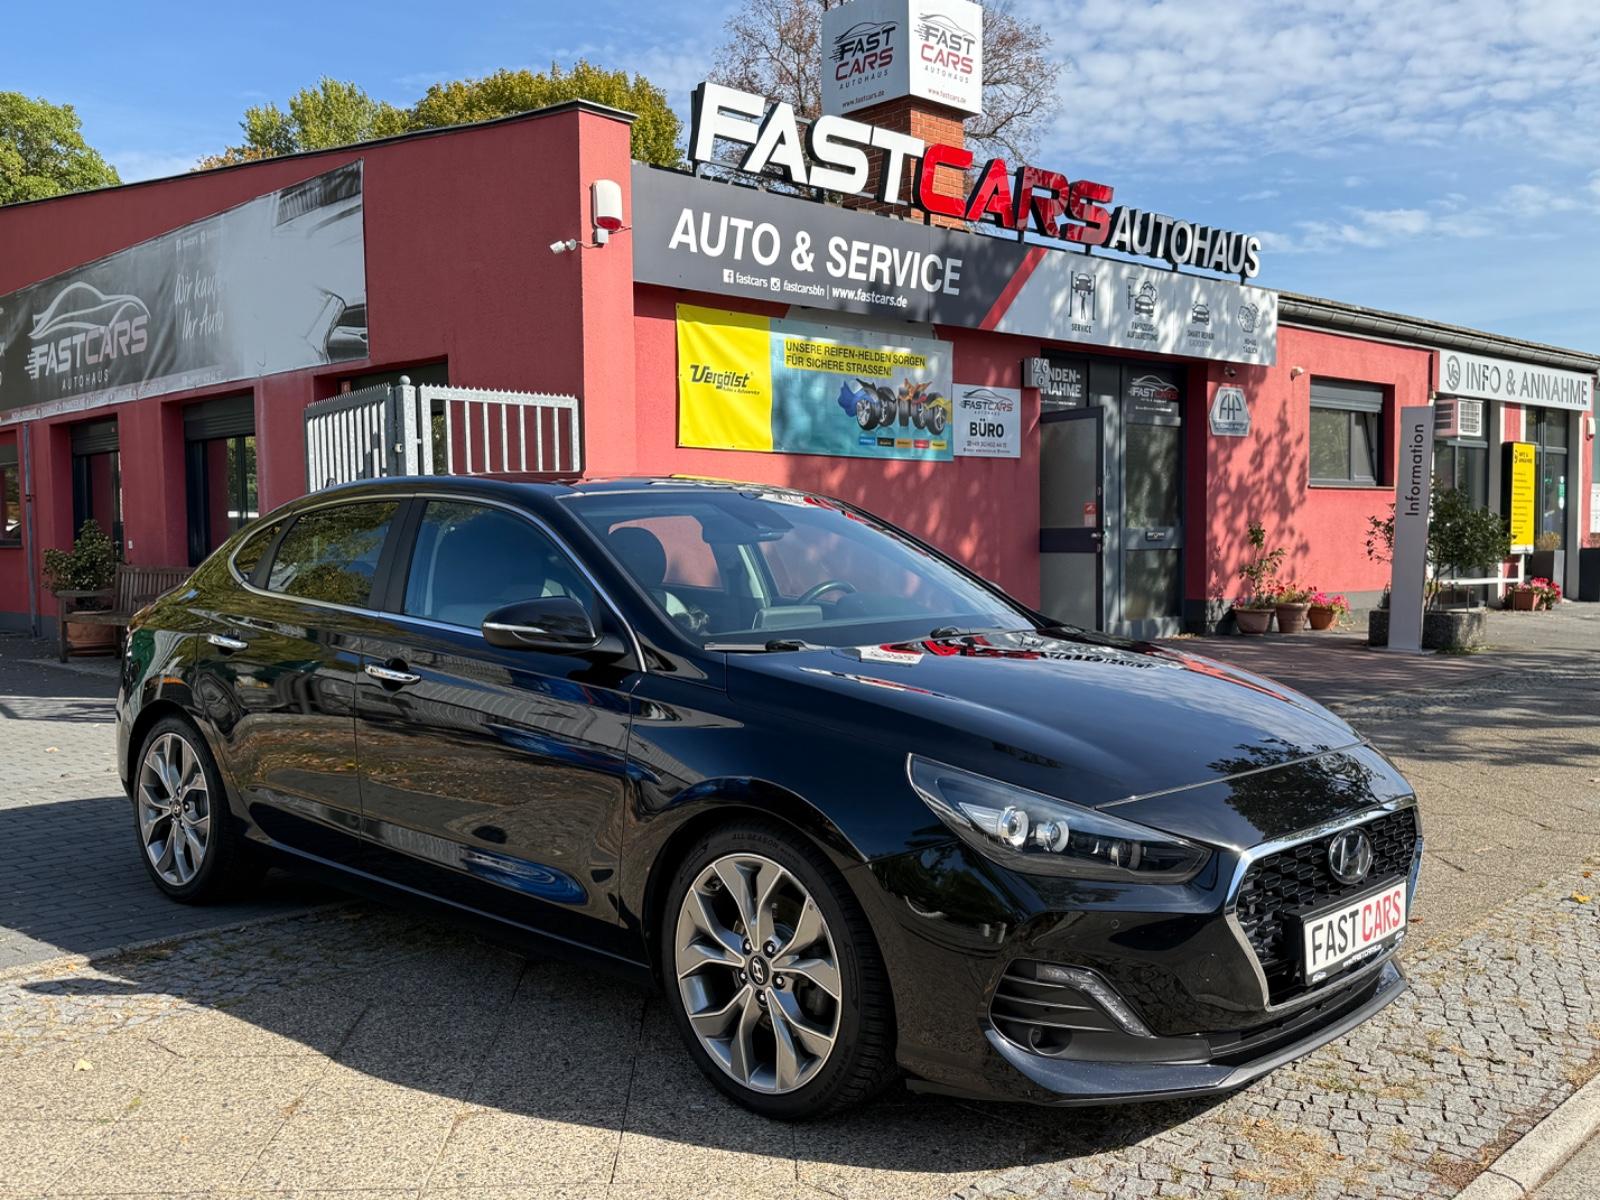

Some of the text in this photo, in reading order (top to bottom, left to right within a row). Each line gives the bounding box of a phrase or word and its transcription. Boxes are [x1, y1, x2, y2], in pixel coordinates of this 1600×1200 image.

[837, 26, 896, 62] FAST
[922, 24, 975, 55] FAST
[836, 47, 894, 81] CARS
[920, 43, 973, 75] CARS
[840, 70, 889, 90] AUTOHAUS
[924, 66, 969, 84] AUTOHAUS
[668, 208, 963, 296] AUTO & SERVICE
[1109, 205, 1262, 279] AUTOHAUS
[735, 273, 908, 308] fastcars fastcarsbln www.fastcars.de
[28, 315, 149, 380] FASTCARS
[786, 340, 925, 367] UNSERE REIFEN-HELDEN SORGEN
[61, 368, 110, 391] AUTOHAUS
[690, 364, 750, 389] Vergölst
[786, 353, 891, 377] FÜR SICHERE STRASSEN!
[1033, 357, 1049, 374] 26
[1466, 361, 1501, 394] INFO
[1506, 368, 1516, 396] &
[1520, 371, 1588, 405] ANNAHME
[961, 400, 1013, 412] FASTCARS
[970, 417, 1004, 438] BÜRO
[1404, 423, 1425, 516] Information
